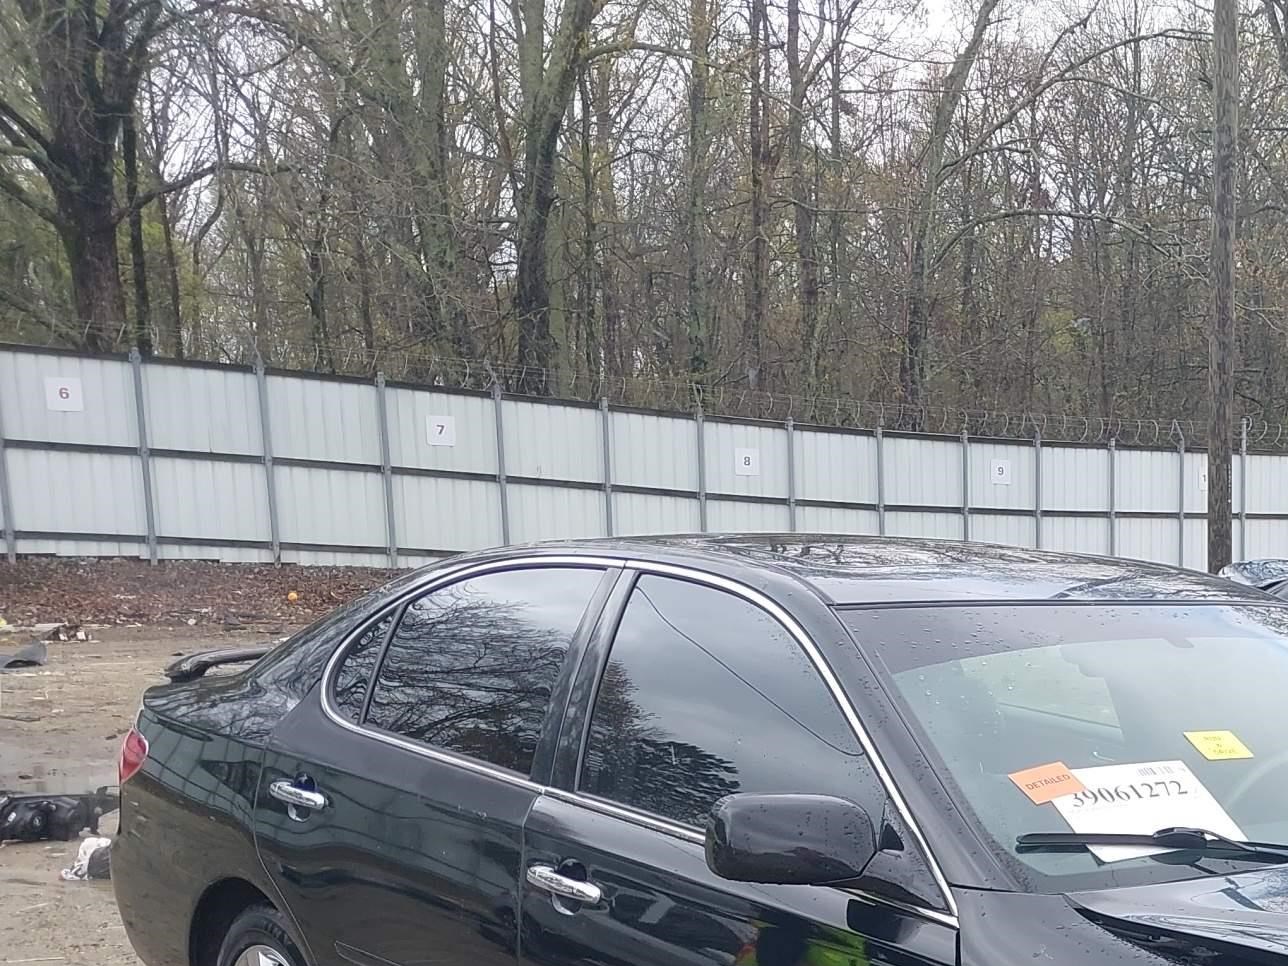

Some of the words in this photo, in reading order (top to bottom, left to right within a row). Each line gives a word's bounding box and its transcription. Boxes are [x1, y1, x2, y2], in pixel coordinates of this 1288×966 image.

[59, 387, 70, 400] 6
[437, 425, 445, 435] 7
[744, 456, 751, 467] 8
[998, 467, 1005, 476] 9
[1025, 774, 1071, 791] DETAILED
[1073, 780, 1188, 808] 39061272
